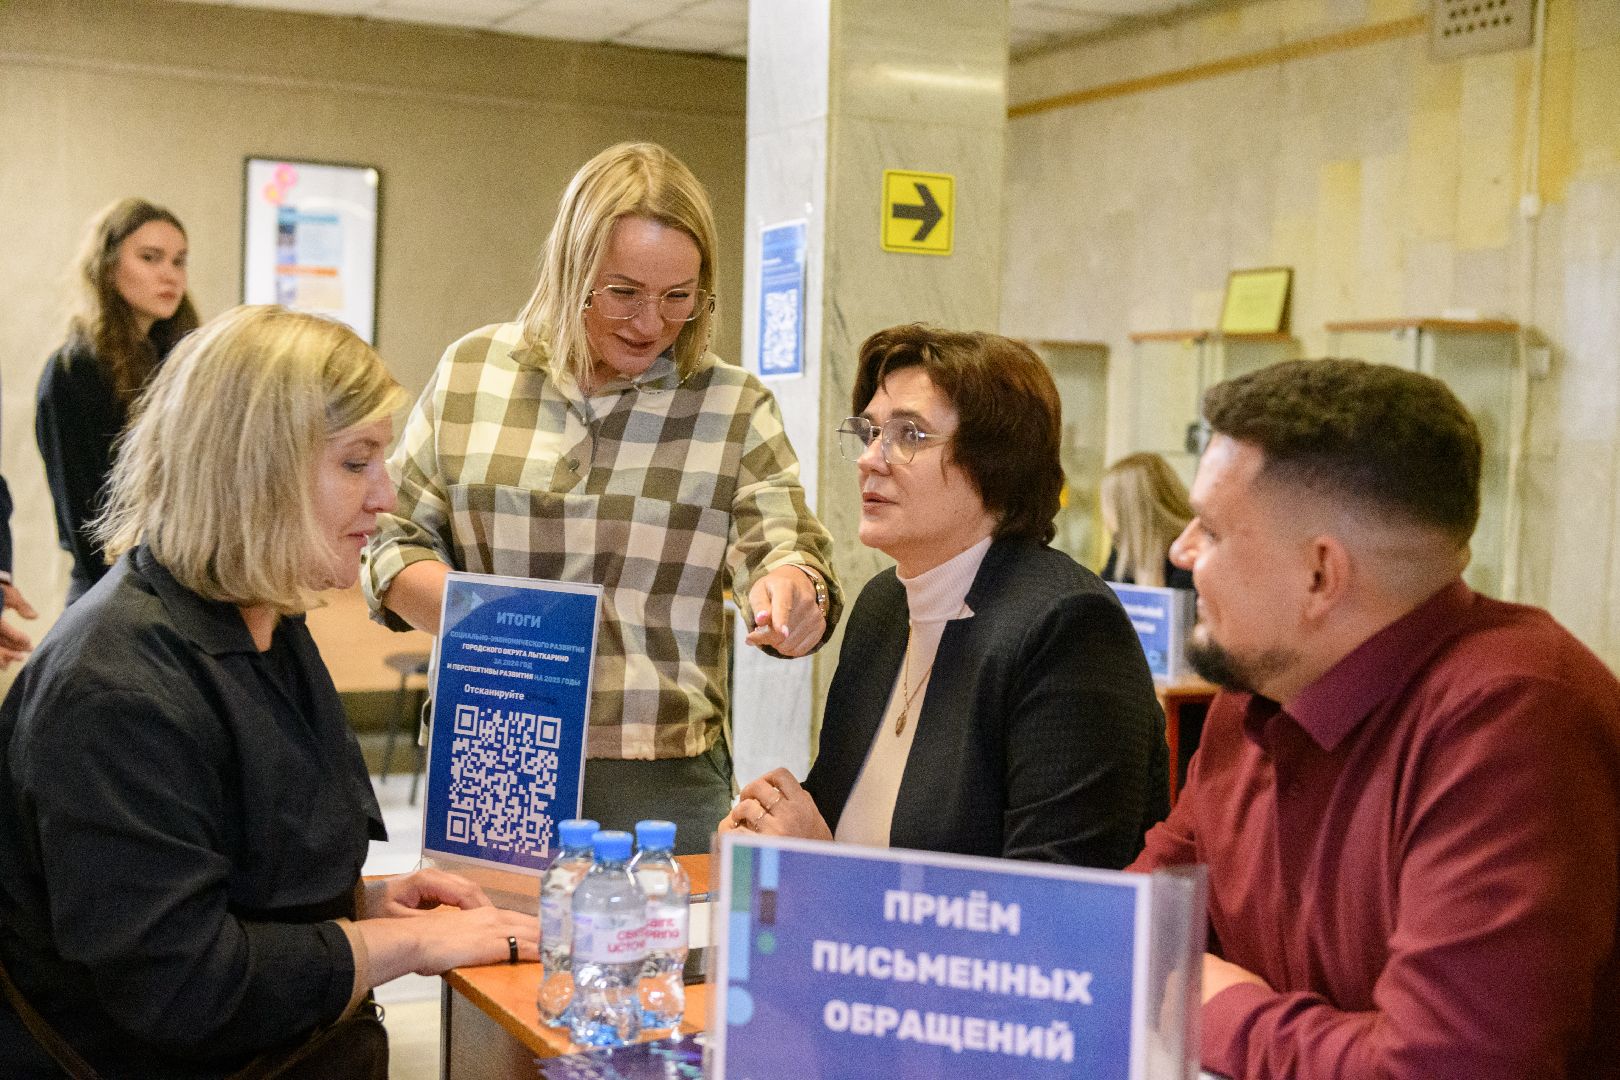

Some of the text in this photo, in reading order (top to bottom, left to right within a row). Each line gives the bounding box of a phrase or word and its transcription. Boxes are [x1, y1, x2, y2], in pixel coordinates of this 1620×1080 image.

[496, 611, 541, 628] ИТОГИ
[462, 643, 569, 662] ГОРОДСКОГО ОКРУГА ЛЫТКАРИНО
[549, 642, 585, 653] РАЗВИТИЯ
[452, 663, 499, 676] ПЕРСПЕКТИВЫ
[500, 670, 534, 680] РАЗВИТИЯ
[520, 661, 533, 670] ГОД
[464, 684, 525, 700] Отсканируйте
[883, 890, 1021, 936] ПРИЁМ
[812, 939, 1094, 1005] ПИСЬМЕННЫХ
[823, 999, 1075, 1063] ОБРАЩЕНИЙ
